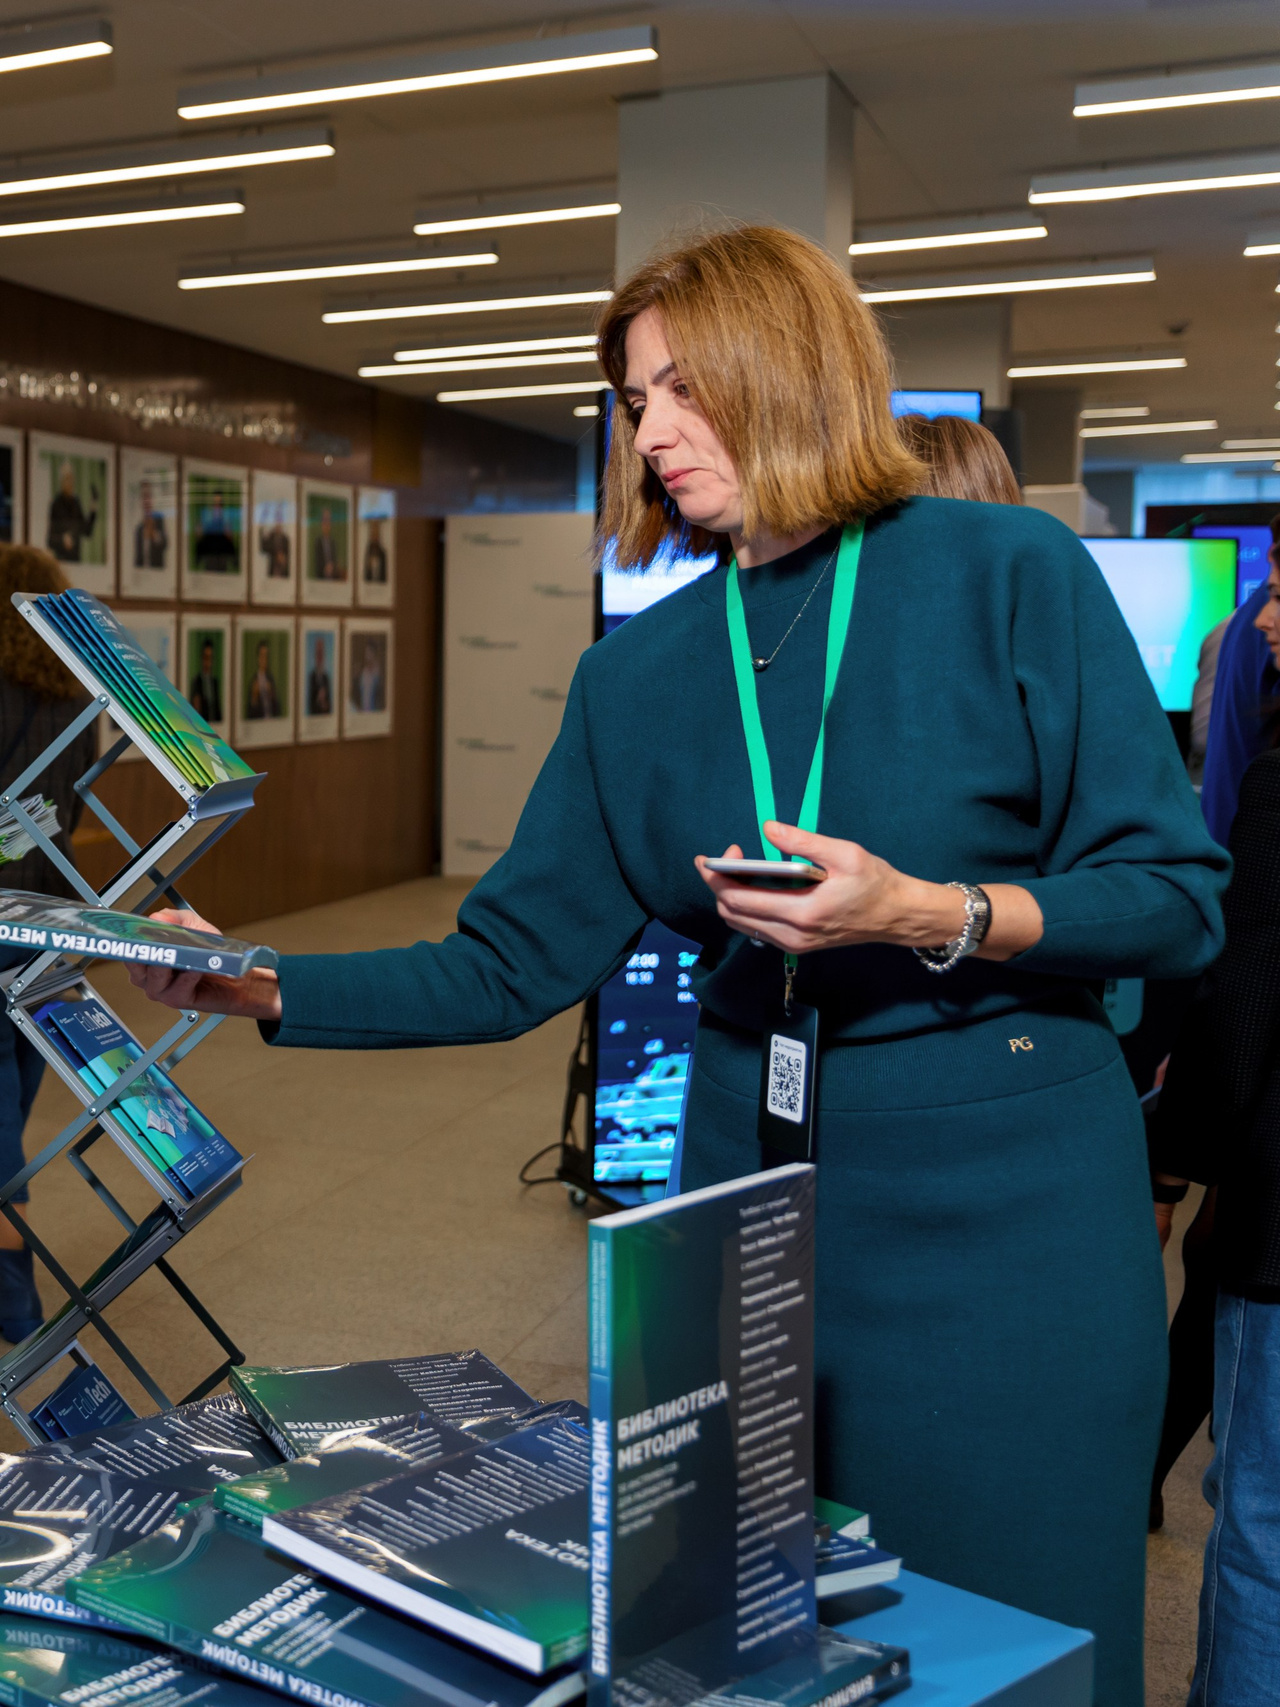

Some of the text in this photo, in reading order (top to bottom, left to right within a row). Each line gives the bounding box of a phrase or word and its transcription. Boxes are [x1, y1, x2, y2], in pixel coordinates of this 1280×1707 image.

[52, 931, 178, 965] БИБЛИОТЕКА
[617, 1380, 729, 1442] БИБЛИОТЕКА
[617, 1419, 700, 1472] МЕТОДИК
[36, 1551, 98, 1592] МЕТОДИК
[590, 1417, 610, 1677] БИБЛИОТЕКА МЕТОДИК
[212, 1571, 314, 1639] БИБЛИОТЕ
[234, 1586, 328, 1648] МЕТОДИК
[60, 1655, 171, 1703] БИБЛИОТЕ
[201, 1638, 285, 1686] МЕТОДИК
